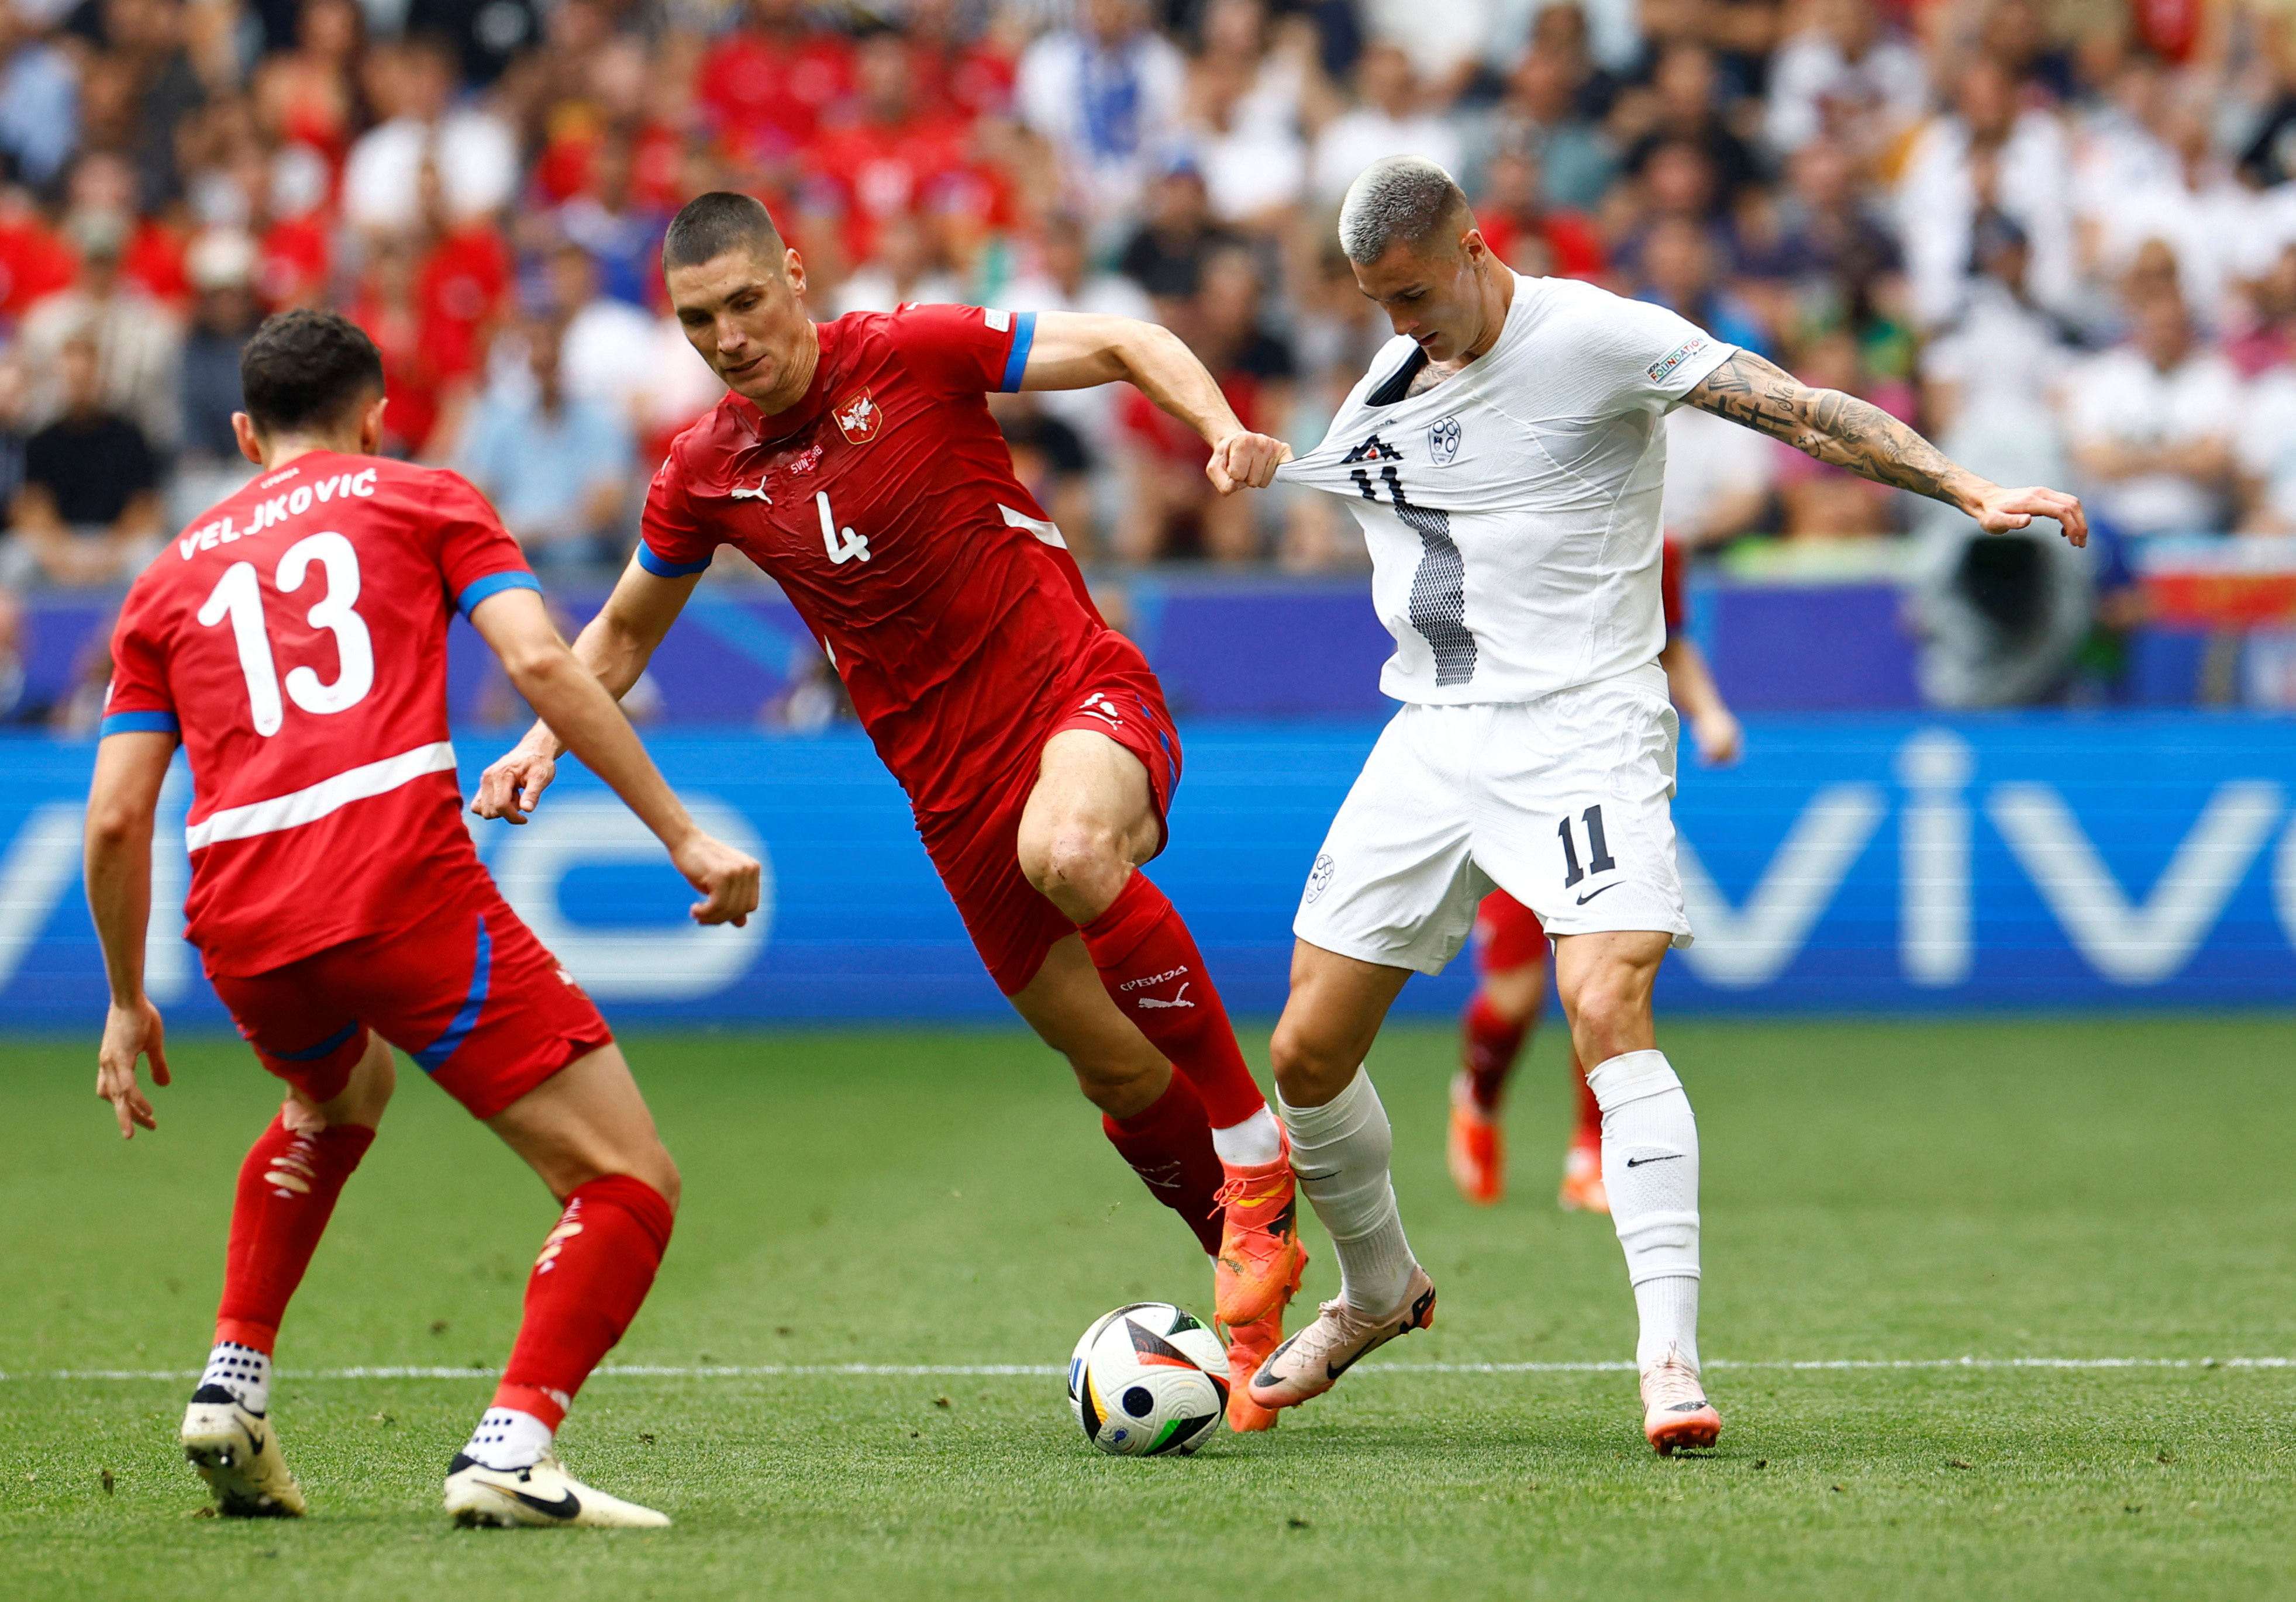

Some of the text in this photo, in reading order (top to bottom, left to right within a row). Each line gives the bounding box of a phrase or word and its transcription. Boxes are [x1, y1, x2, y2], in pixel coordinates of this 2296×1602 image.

[1646, 362, 1660, 375] UEFA
[1650, 337, 1704, 381] FOUNDATION
[179, 467, 377, 561] VELJKOVIĆ
[816, 491, 871, 564] 4
[197, 531, 375, 737] 13
[1558, 804, 1616, 889] 11
[1675, 727, 2296, 990] viv
[1120, 965, 1188, 991] СРБИЈА
